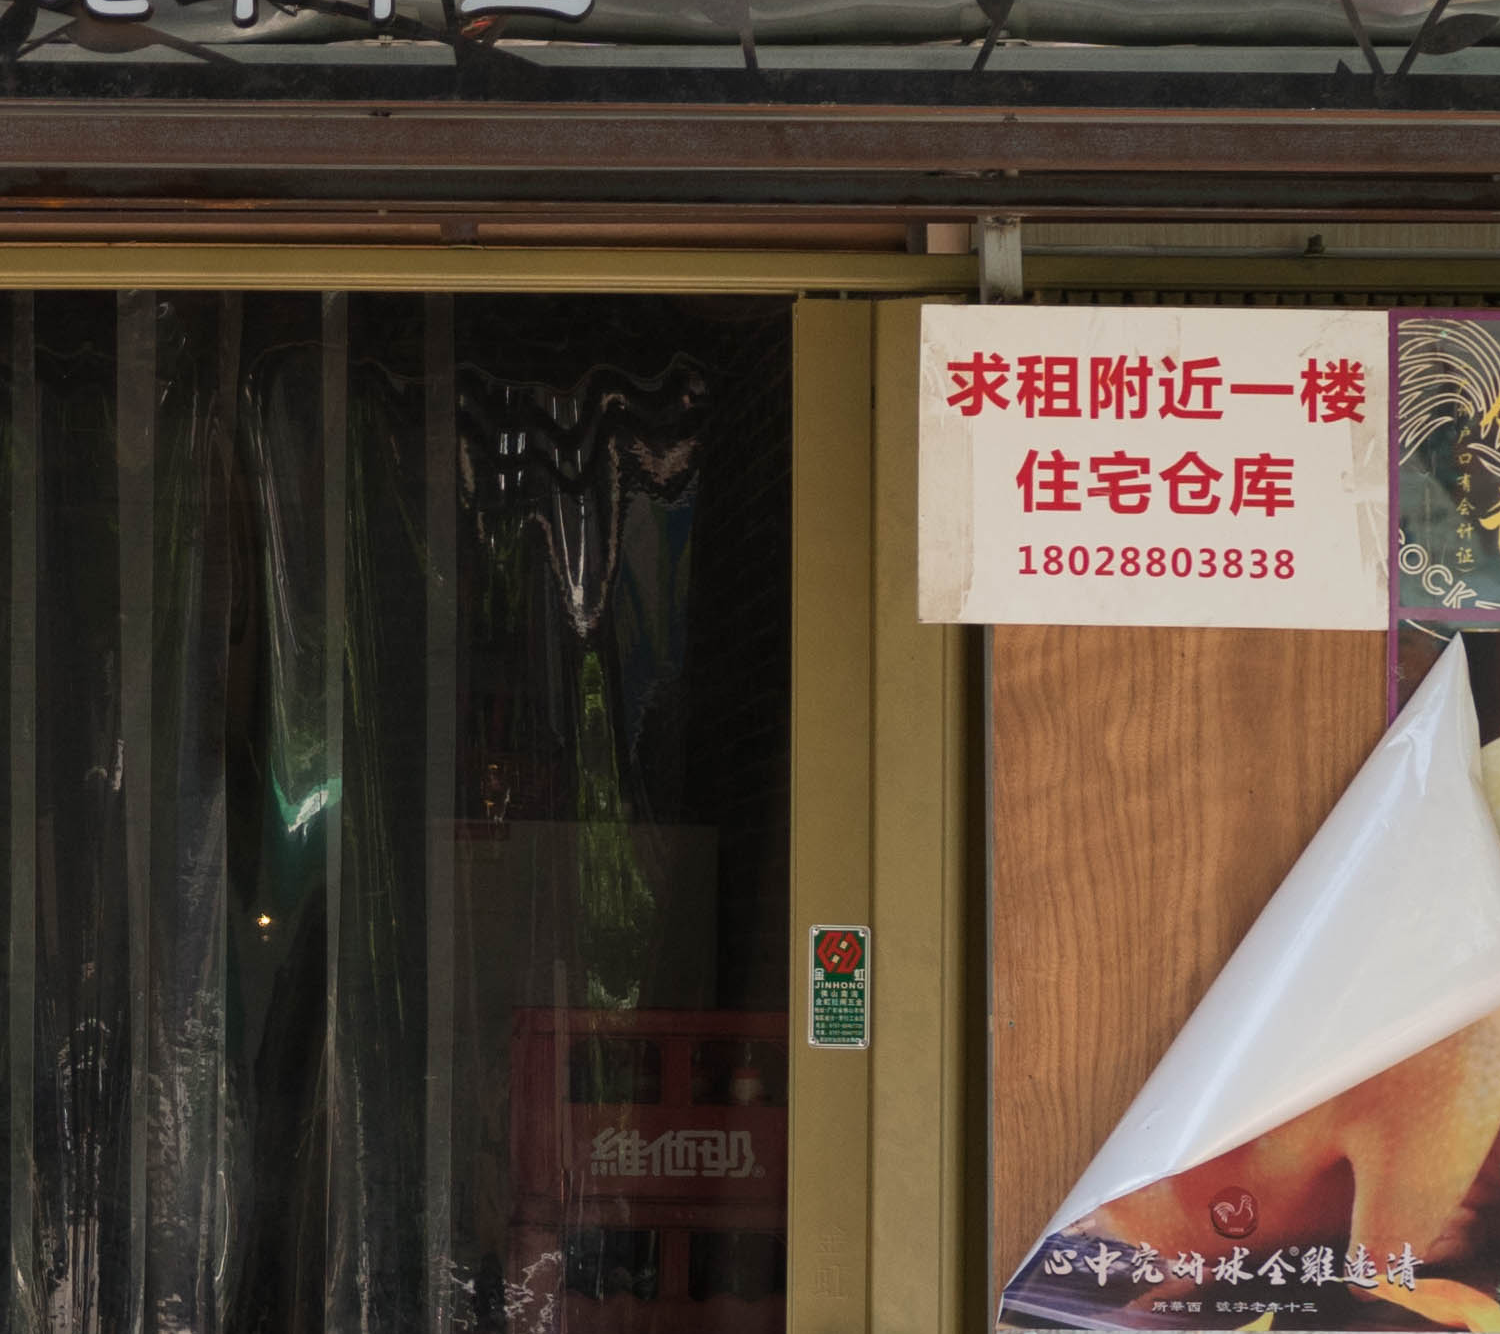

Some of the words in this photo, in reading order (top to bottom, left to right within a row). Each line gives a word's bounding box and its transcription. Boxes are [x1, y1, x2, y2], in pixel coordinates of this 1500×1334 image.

[946, 351, 1367, 425] 求租附近一楼
[1014, 448, 1297, 518] 住宅仓库
[1016, 543, 1297, 581] 18028803838
[591, 1127, 756, 1179] 維他奶
